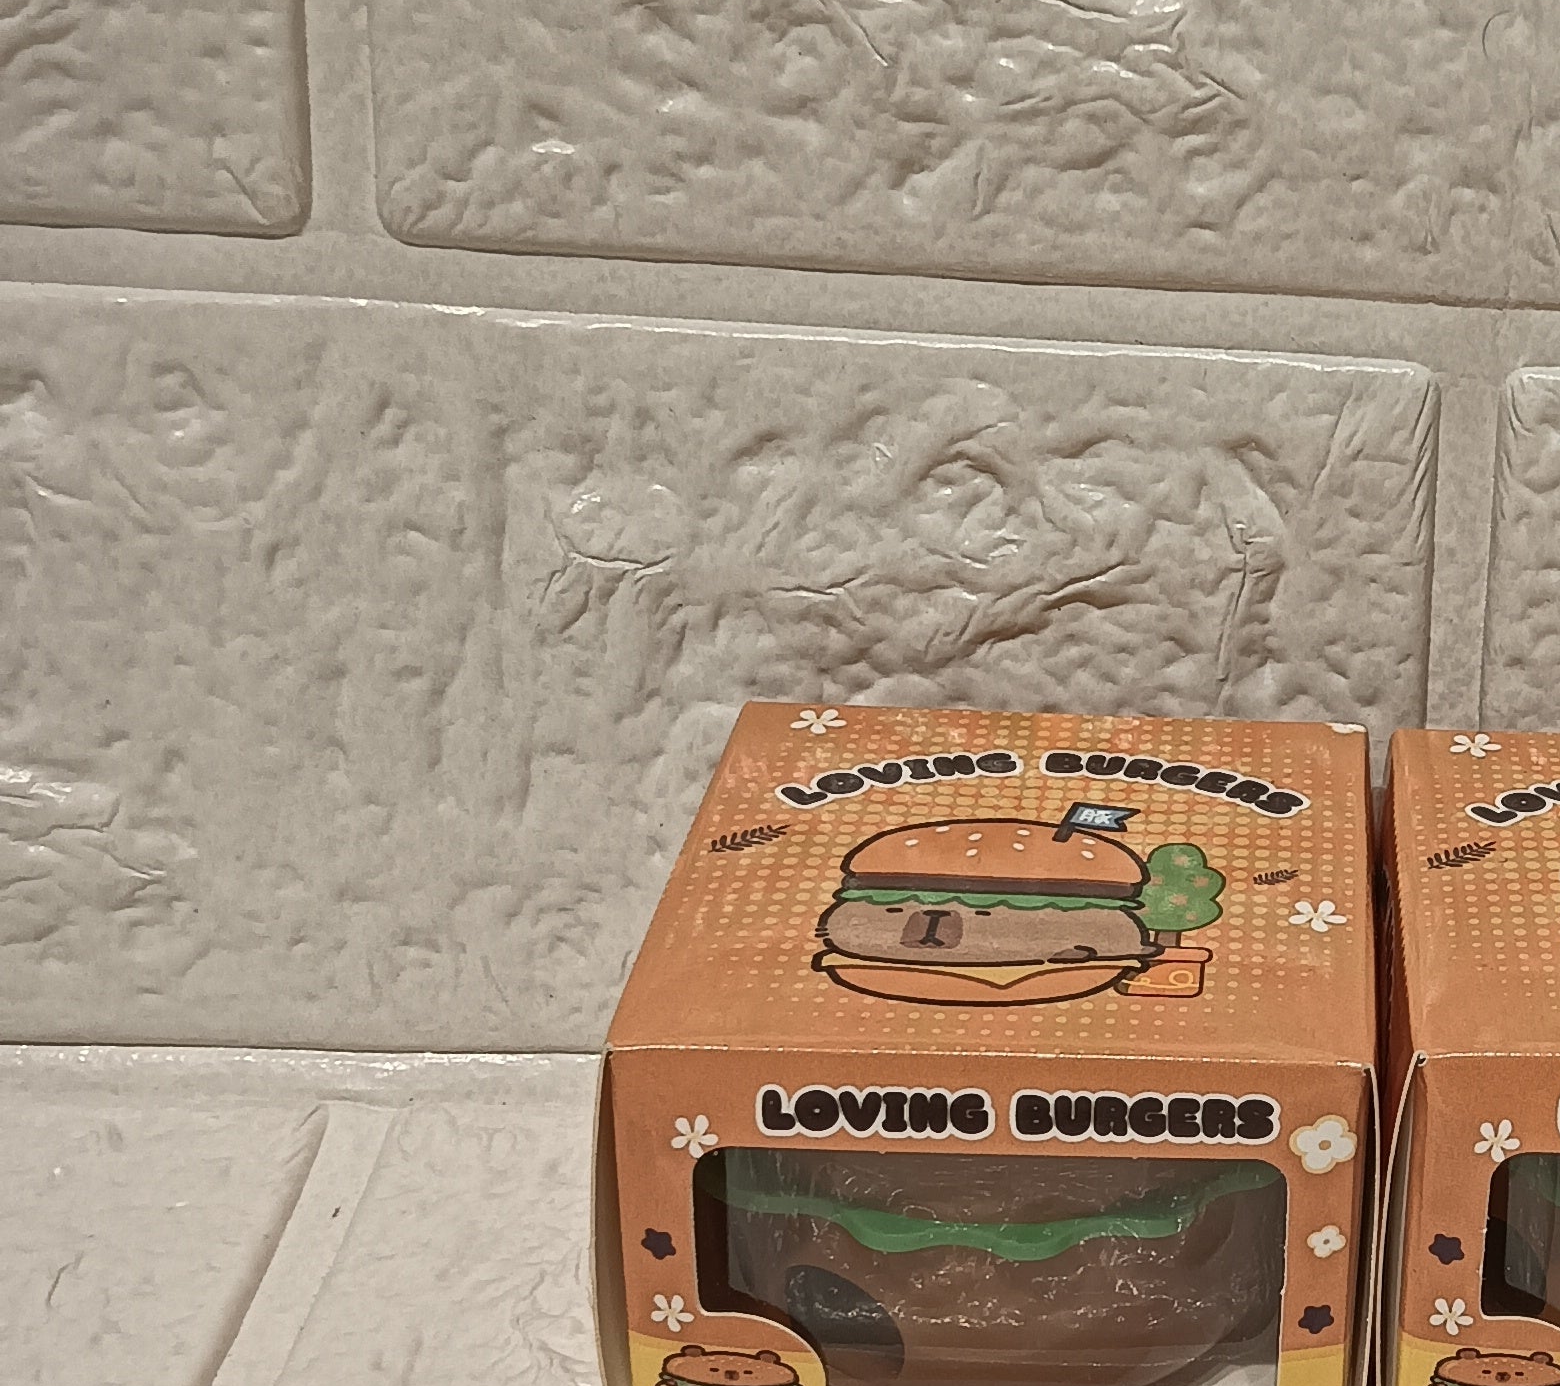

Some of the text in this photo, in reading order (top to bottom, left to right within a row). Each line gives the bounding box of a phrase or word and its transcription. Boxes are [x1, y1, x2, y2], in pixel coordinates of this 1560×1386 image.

[781, 752, 1305, 815] LOVING BURGERS
[762, 1088, 1275, 1140] LOVING BURGERS
